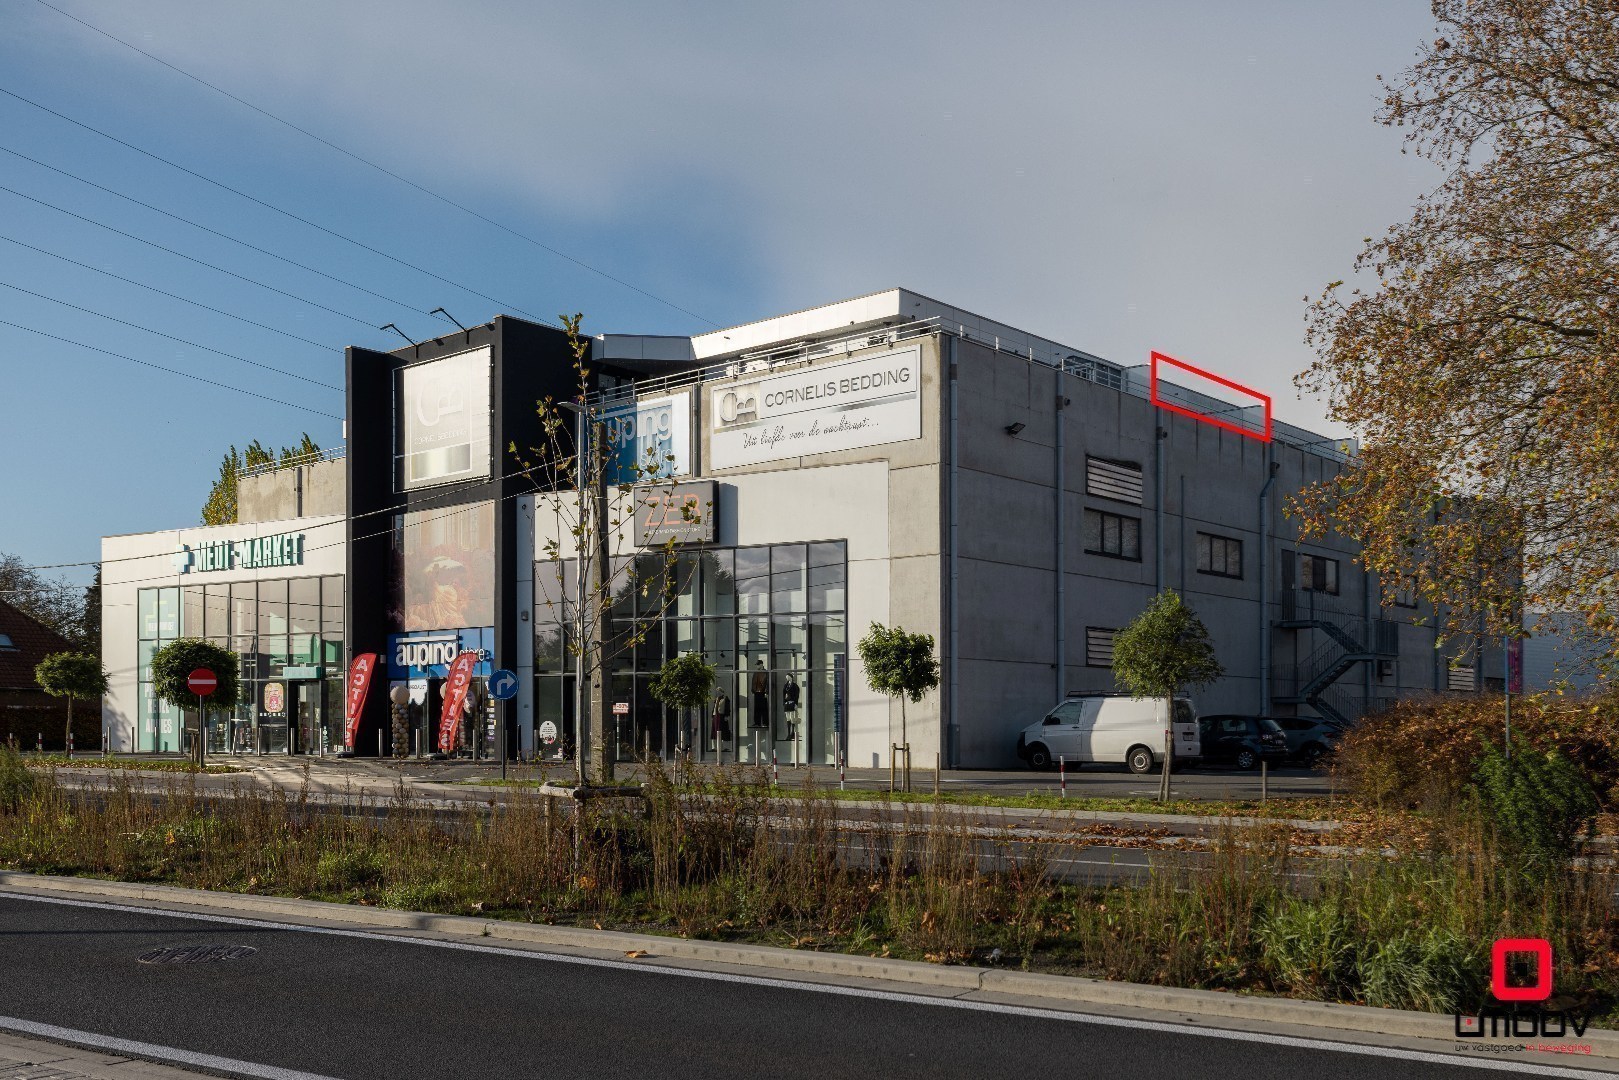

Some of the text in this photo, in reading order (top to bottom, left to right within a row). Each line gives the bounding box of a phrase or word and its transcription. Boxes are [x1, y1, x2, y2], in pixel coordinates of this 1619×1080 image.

[765, 367, 910, 407] CORNELIS BEDDING
[644, 493, 702, 526] ZEB
[395, 635, 458, 672] auping
